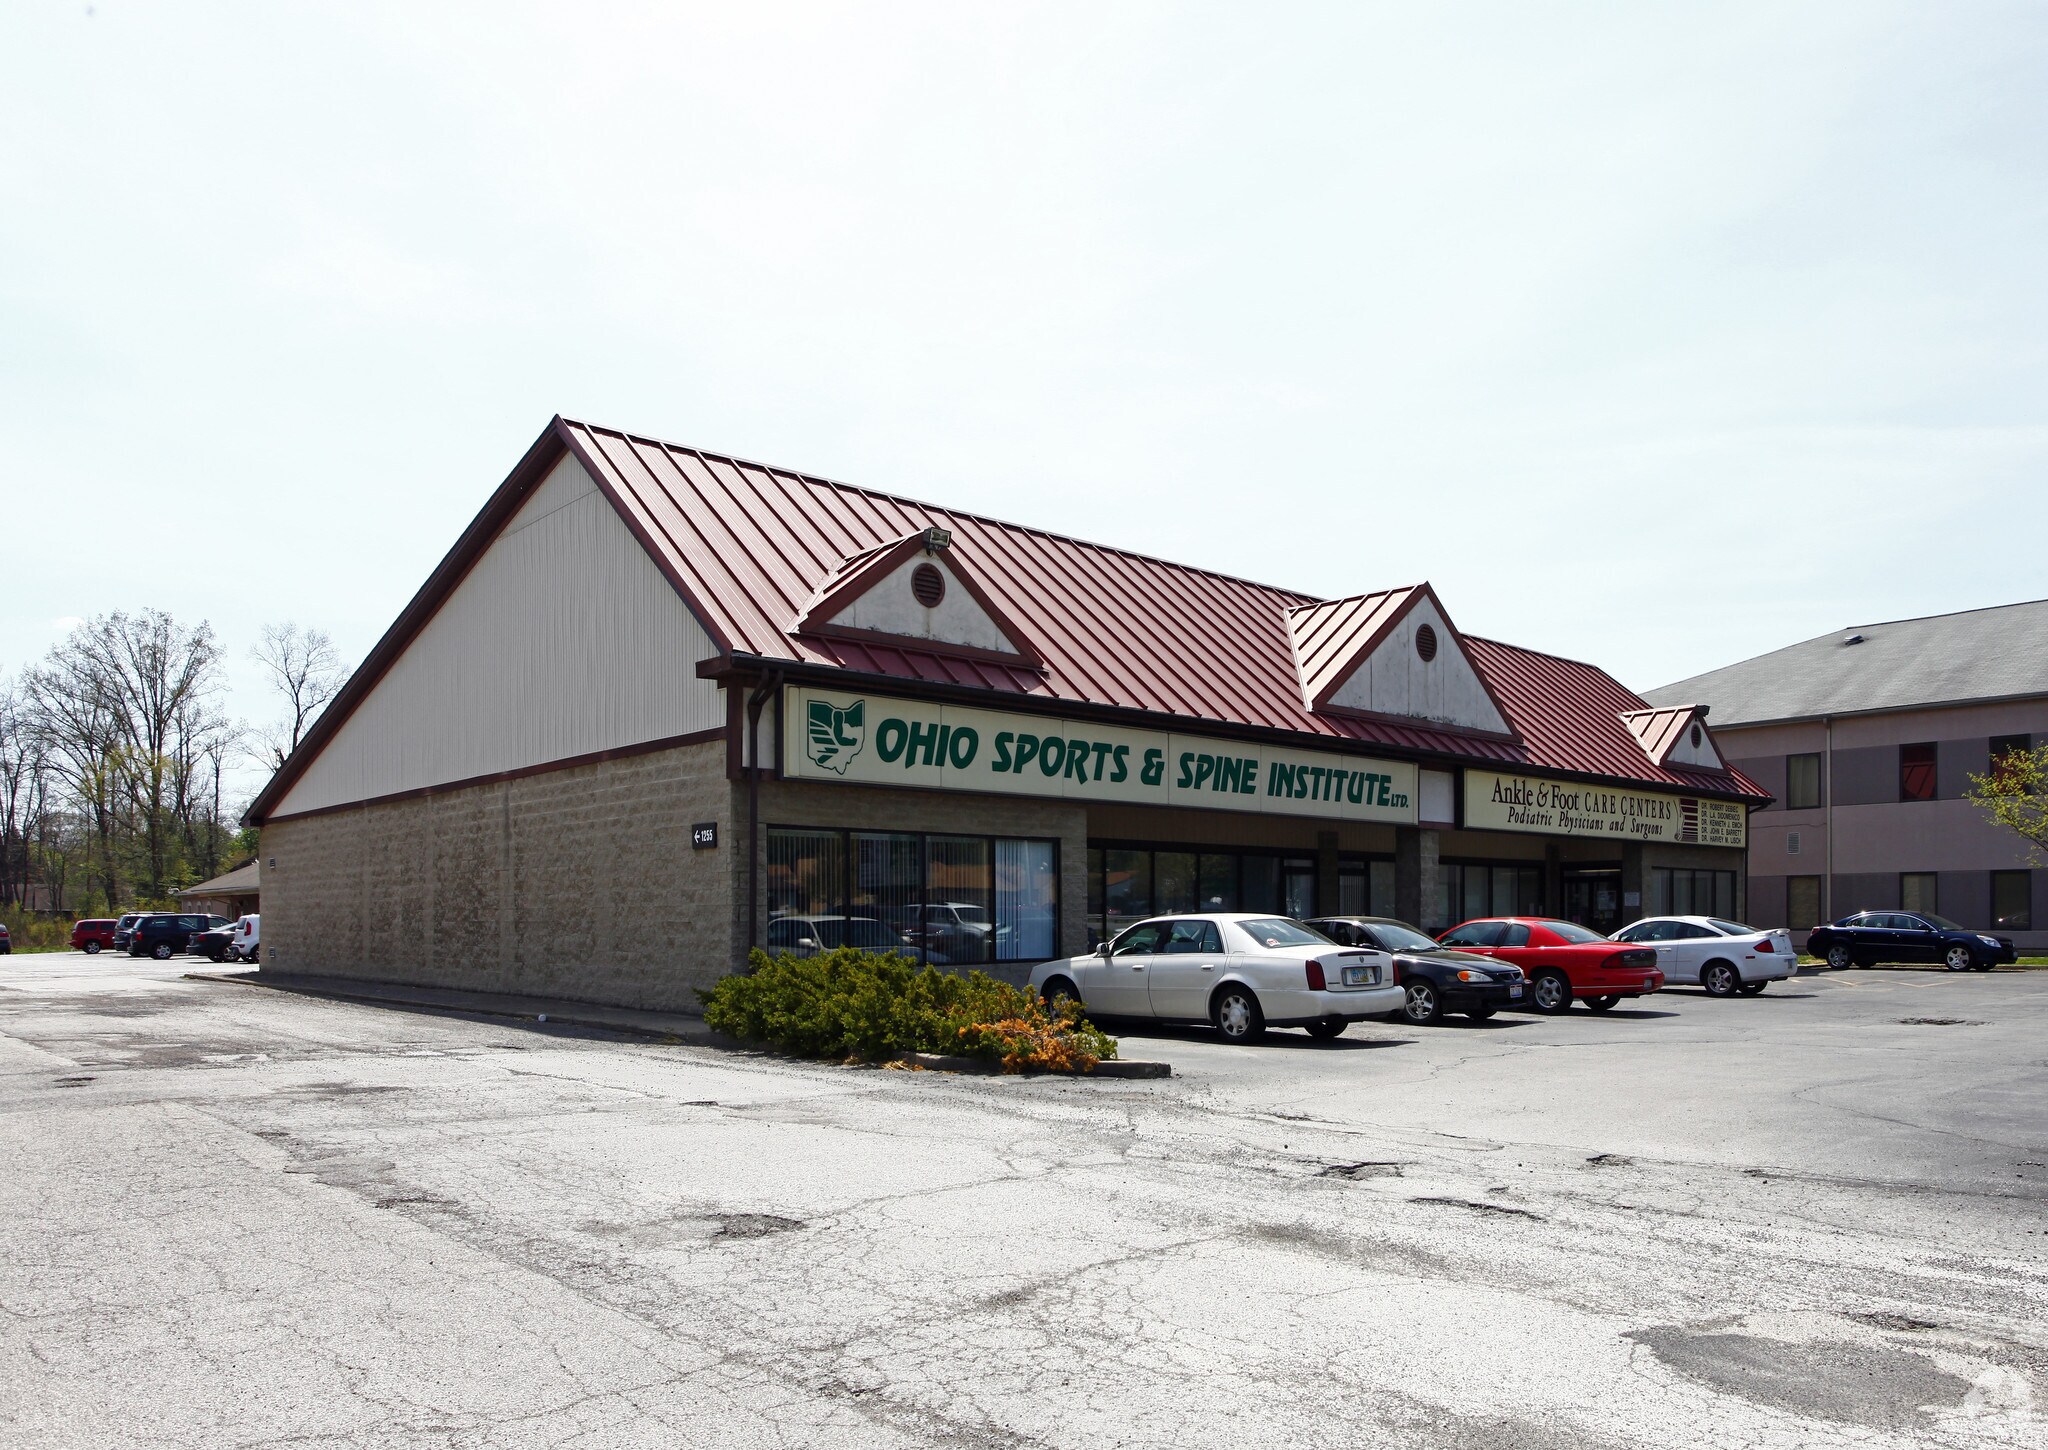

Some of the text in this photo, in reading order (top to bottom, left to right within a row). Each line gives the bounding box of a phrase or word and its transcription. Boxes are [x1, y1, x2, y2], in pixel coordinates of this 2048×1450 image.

[875, 718, 1409, 808] OHIO SPORTS & SPINE INSTITUTE LTD.
[1491, 777, 1671, 820] Ankle & Foot CARE CENTERS
[701, 829, 713, 842] 1255
[1507, 806, 1663, 839] Podiatric Physicians and Surgeons
